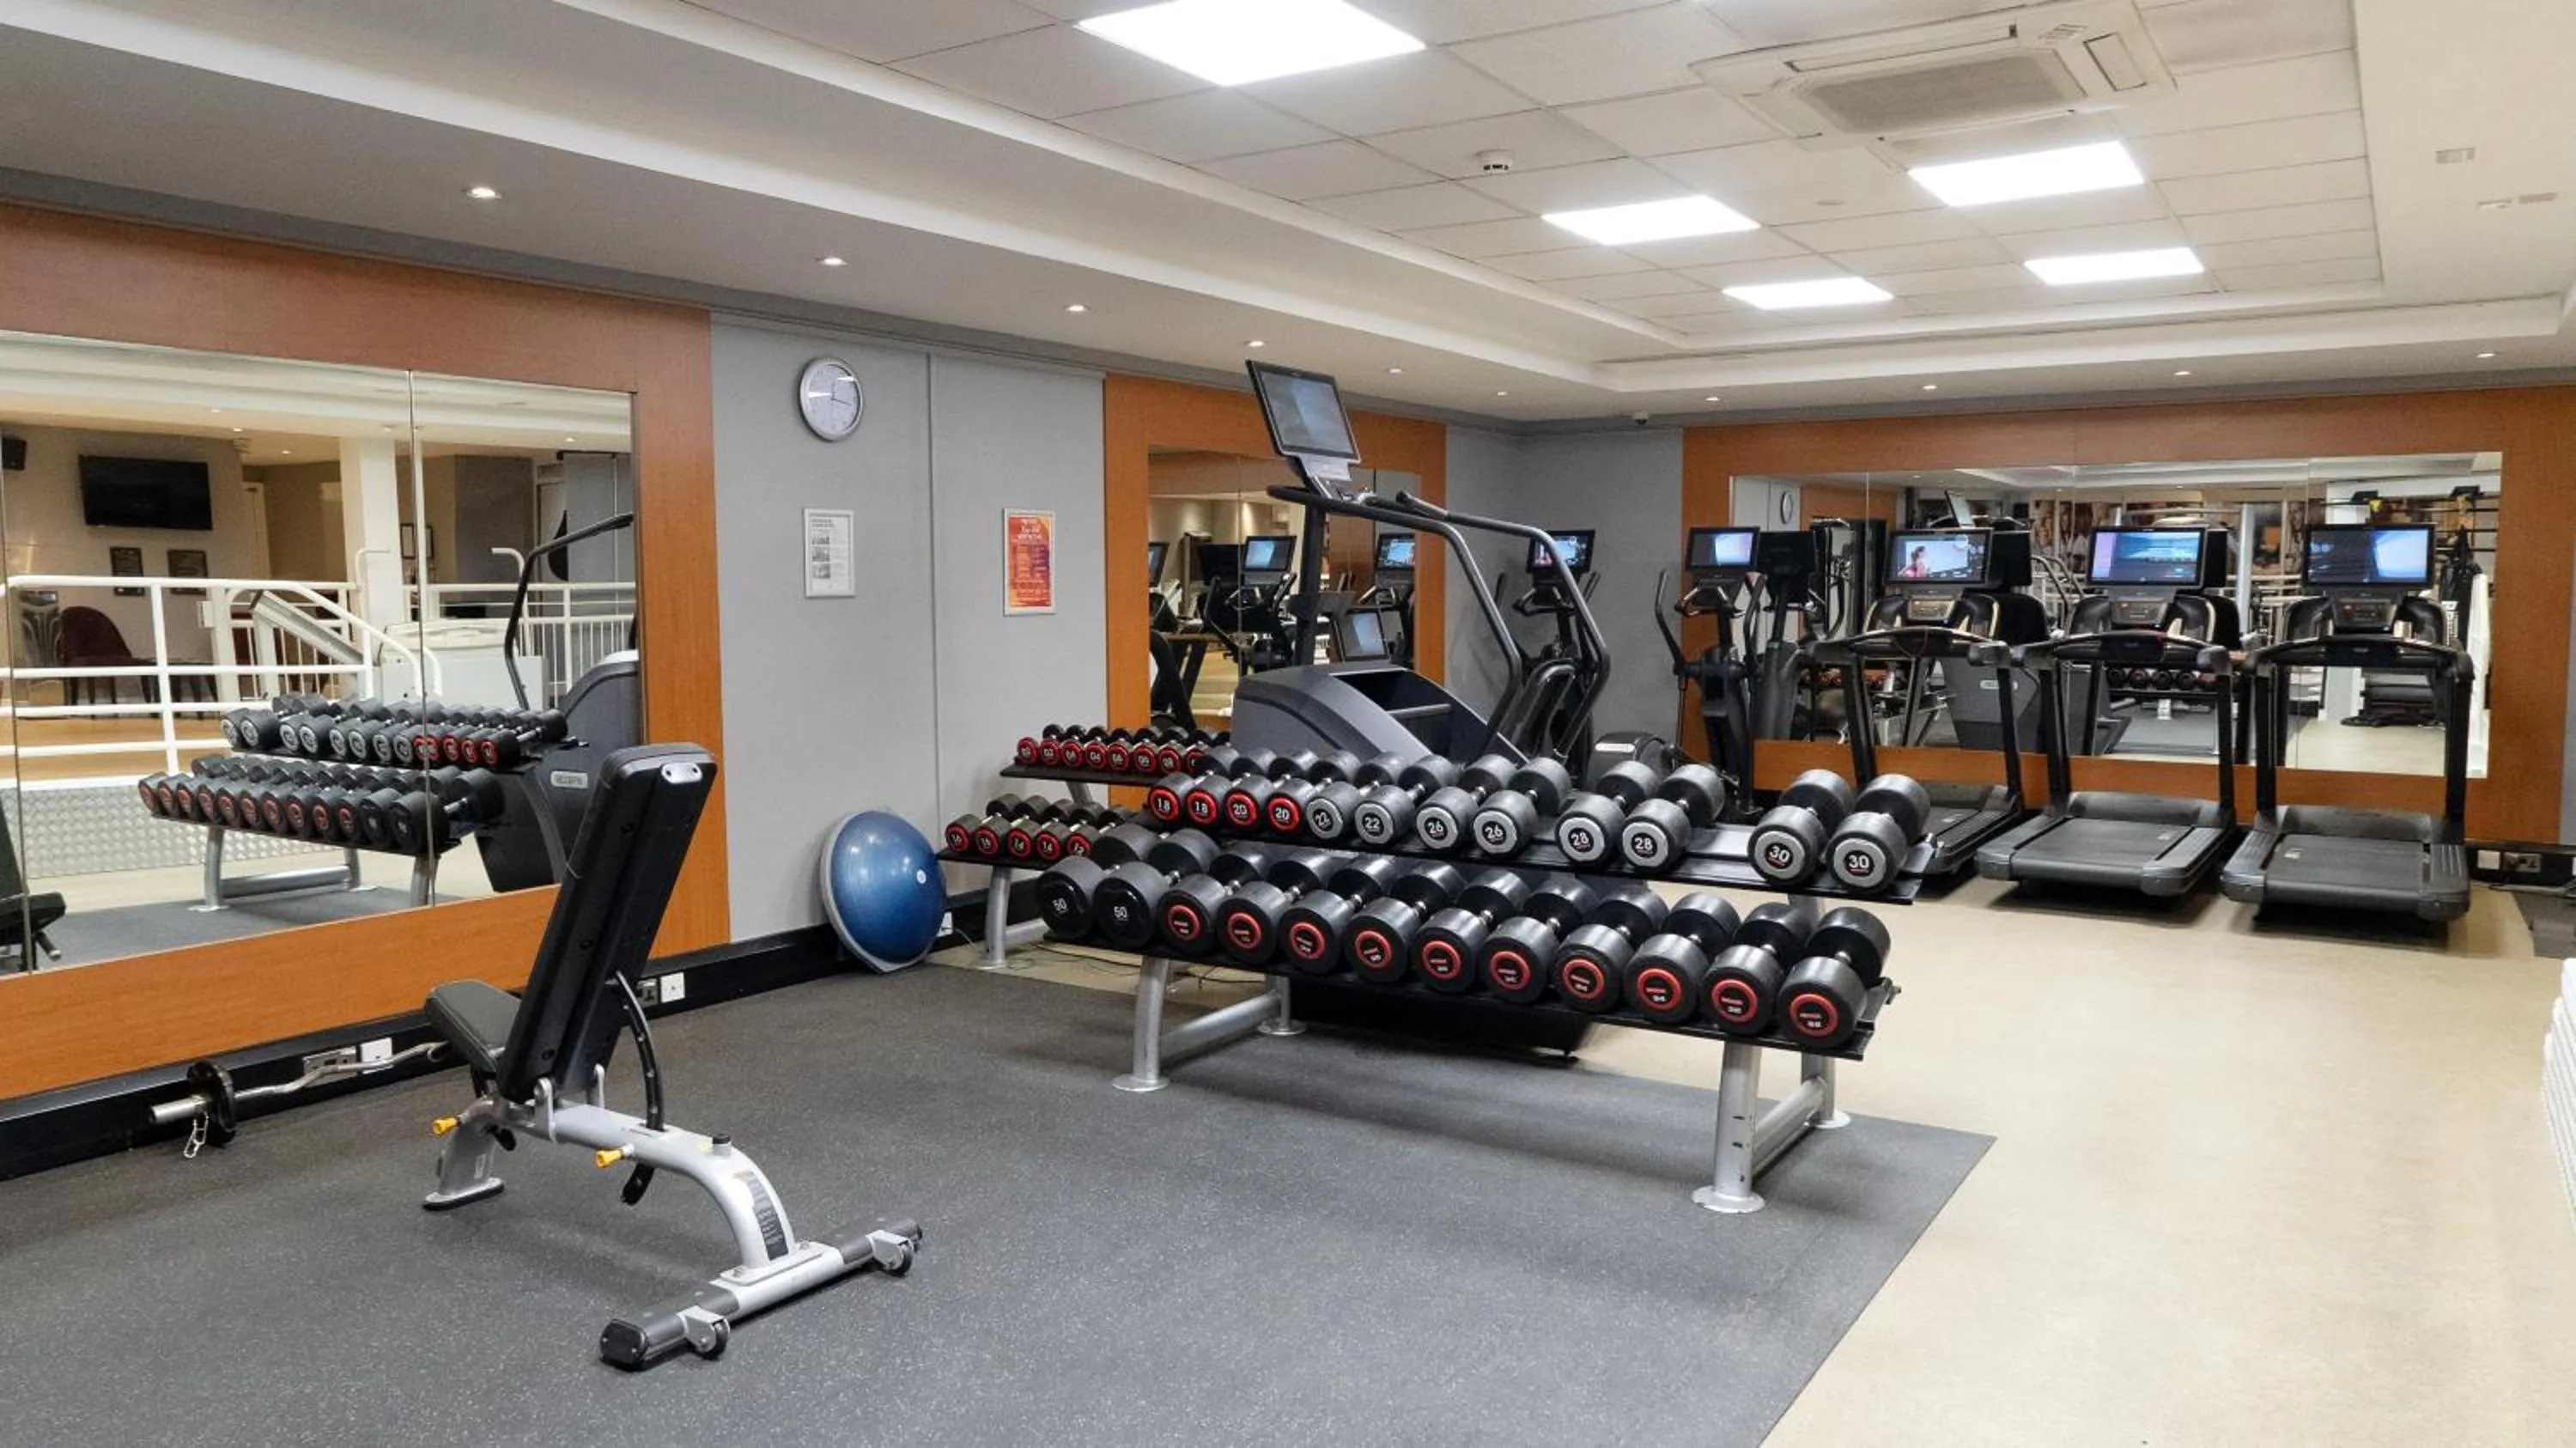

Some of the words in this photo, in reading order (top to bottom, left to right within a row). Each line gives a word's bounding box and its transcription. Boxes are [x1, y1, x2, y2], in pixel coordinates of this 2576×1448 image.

[1157, 798, 1170, 812] 18
[1195, 800, 1208, 814] 18
[1233, 803, 1248, 816] 20
[1275, 806, 1291, 820] 20
[1315, 812, 1331, 827] 22
[1364, 817, 1380, 829] 22
[1428, 821, 1443, 834] 26
[1485, 824, 1504, 839] 26
[1571, 831, 1589, 846] 28
[1634, 837, 1654, 851] 28
[1769, 846, 1790, 863] 30
[1849, 855, 1870, 869] 30
[1053, 897, 1067, 912] 50
[1114, 906, 1127, 919] 50
